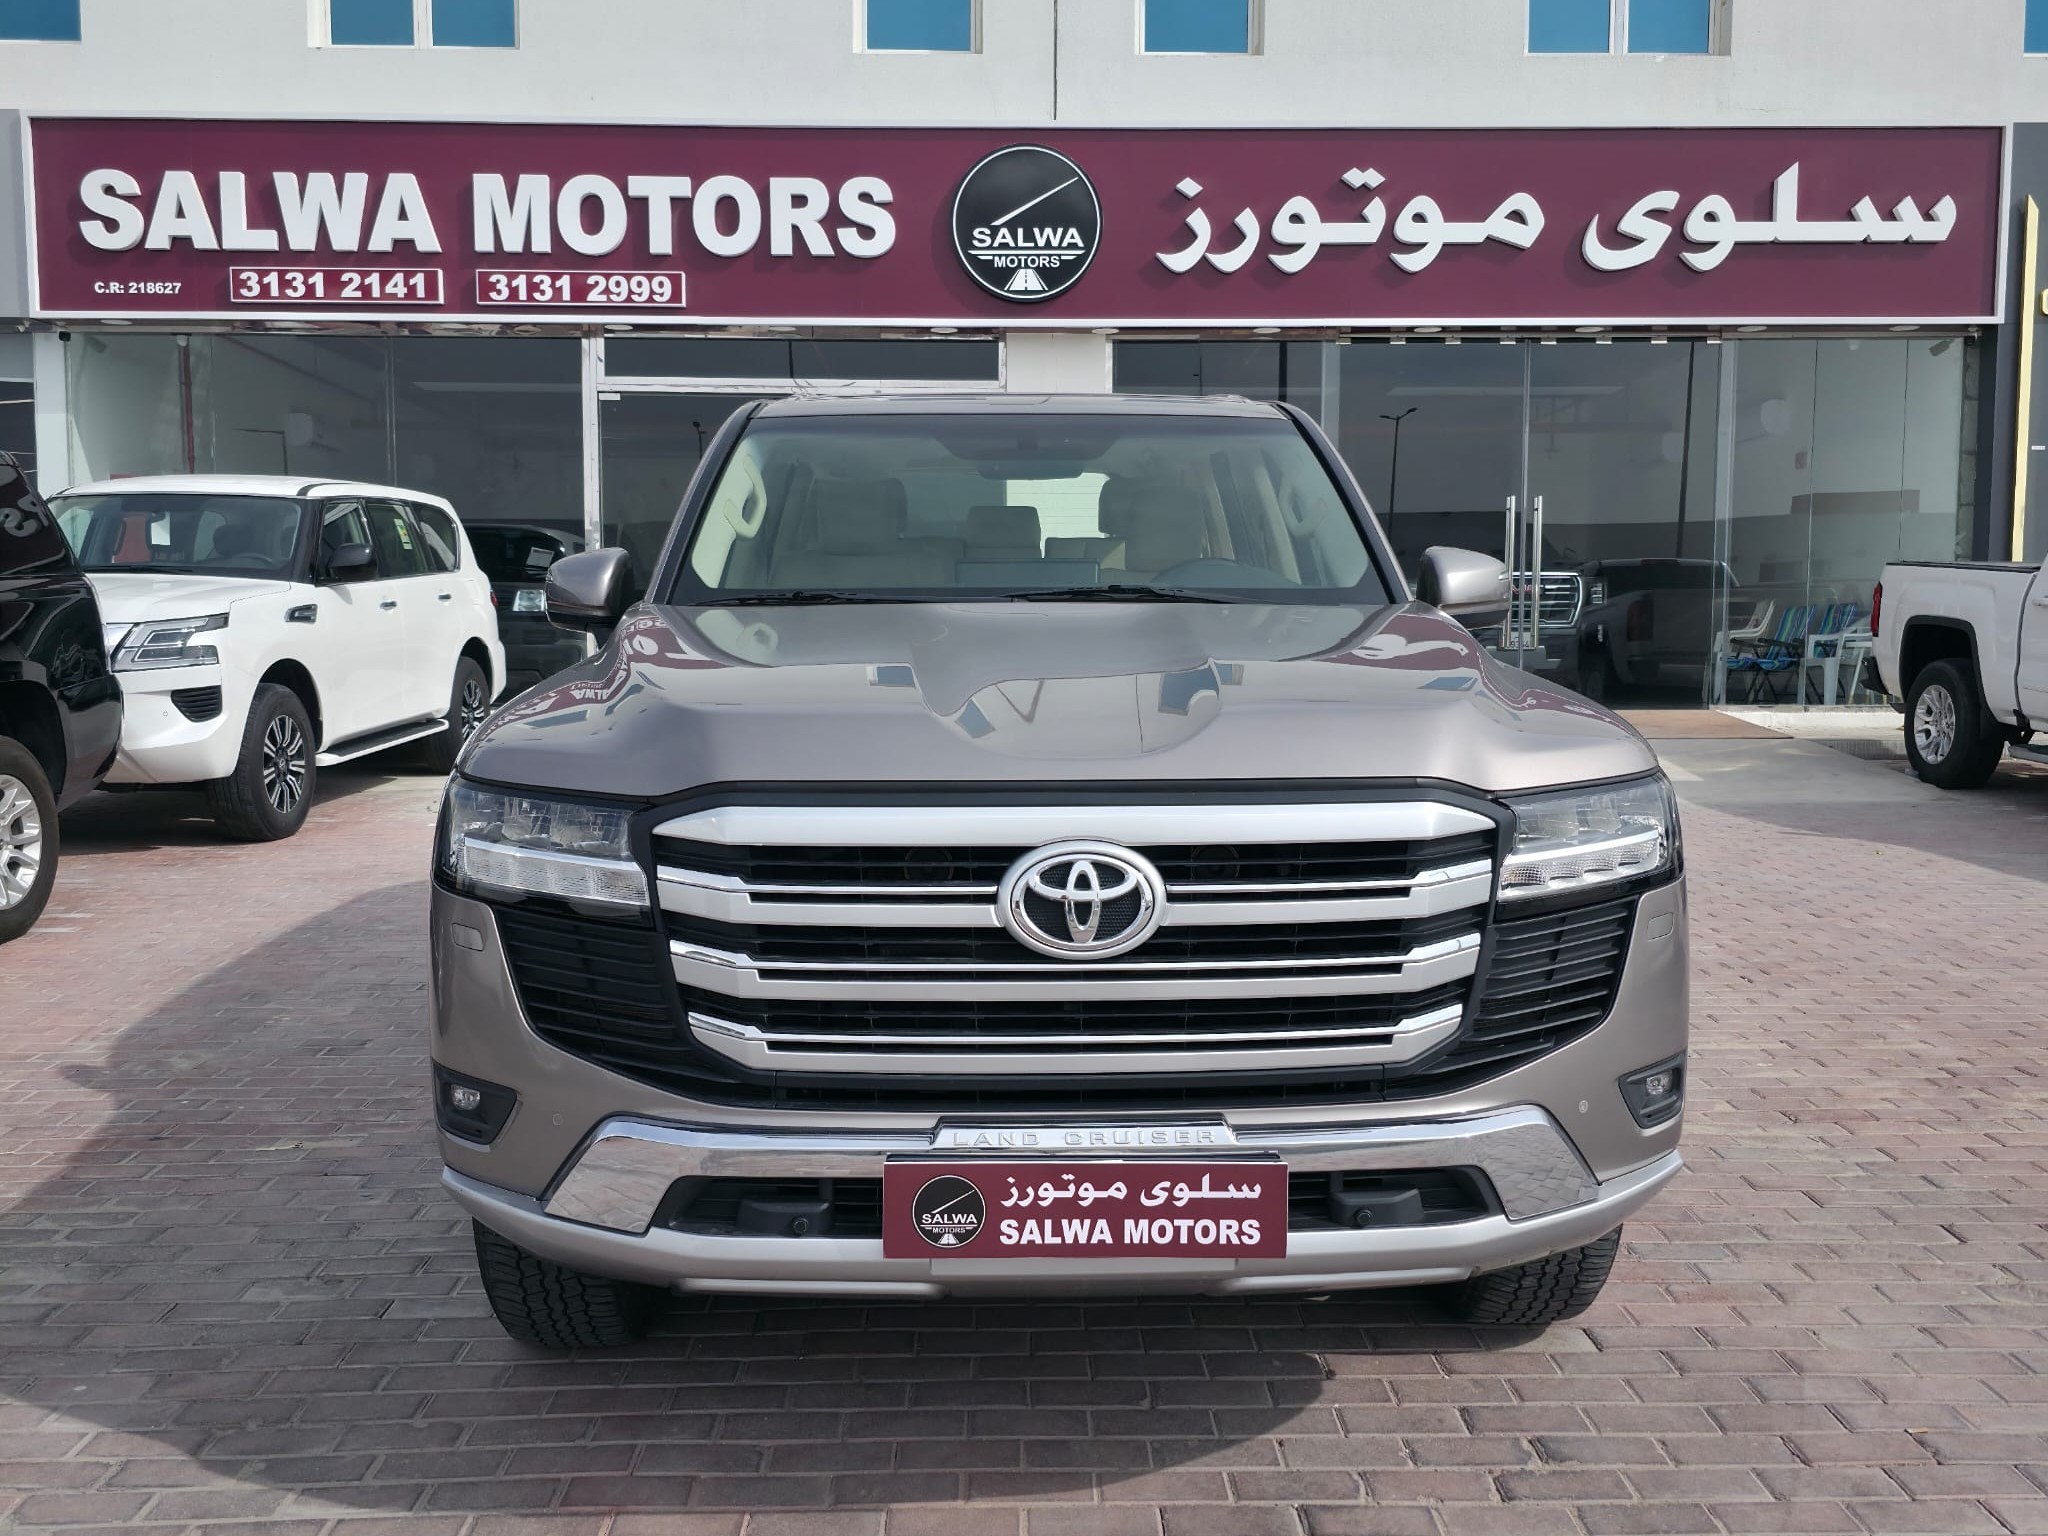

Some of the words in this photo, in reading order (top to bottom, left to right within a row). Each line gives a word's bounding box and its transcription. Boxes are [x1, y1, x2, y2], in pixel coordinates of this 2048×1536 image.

[79, 168, 443, 253] SALWA
[472, 173, 897, 259] MOTORS
[1156, 167, 1546, 274] موتورز
[1582, 161, 1957, 271] سلوى
[971, 227, 1085, 248] SALWA
[993, 255, 1061, 268] MOTORS
[94, 281, 125, 294] C.R:
[128, 281, 182, 294] 218627
[239, 271, 325, 298] 3131
[340, 271, 426, 298] 2141
[488, 274, 571, 302] 3131
[586, 275, 672, 303] 2999
[953, 1131, 1041, 1147] LAND
[1064, 1128, 1216, 1145] CRUISER
[1000, 1173, 1128, 1208] موتورز
[1139, 1172, 1262, 1208] سلوى
[921, 1213, 978, 1224] SALWA
[932, 1226, 966, 1234] MOTORS
[999, 1219, 1113, 1245] SALWA
[1123, 1218, 1261, 1245] MOTORS
